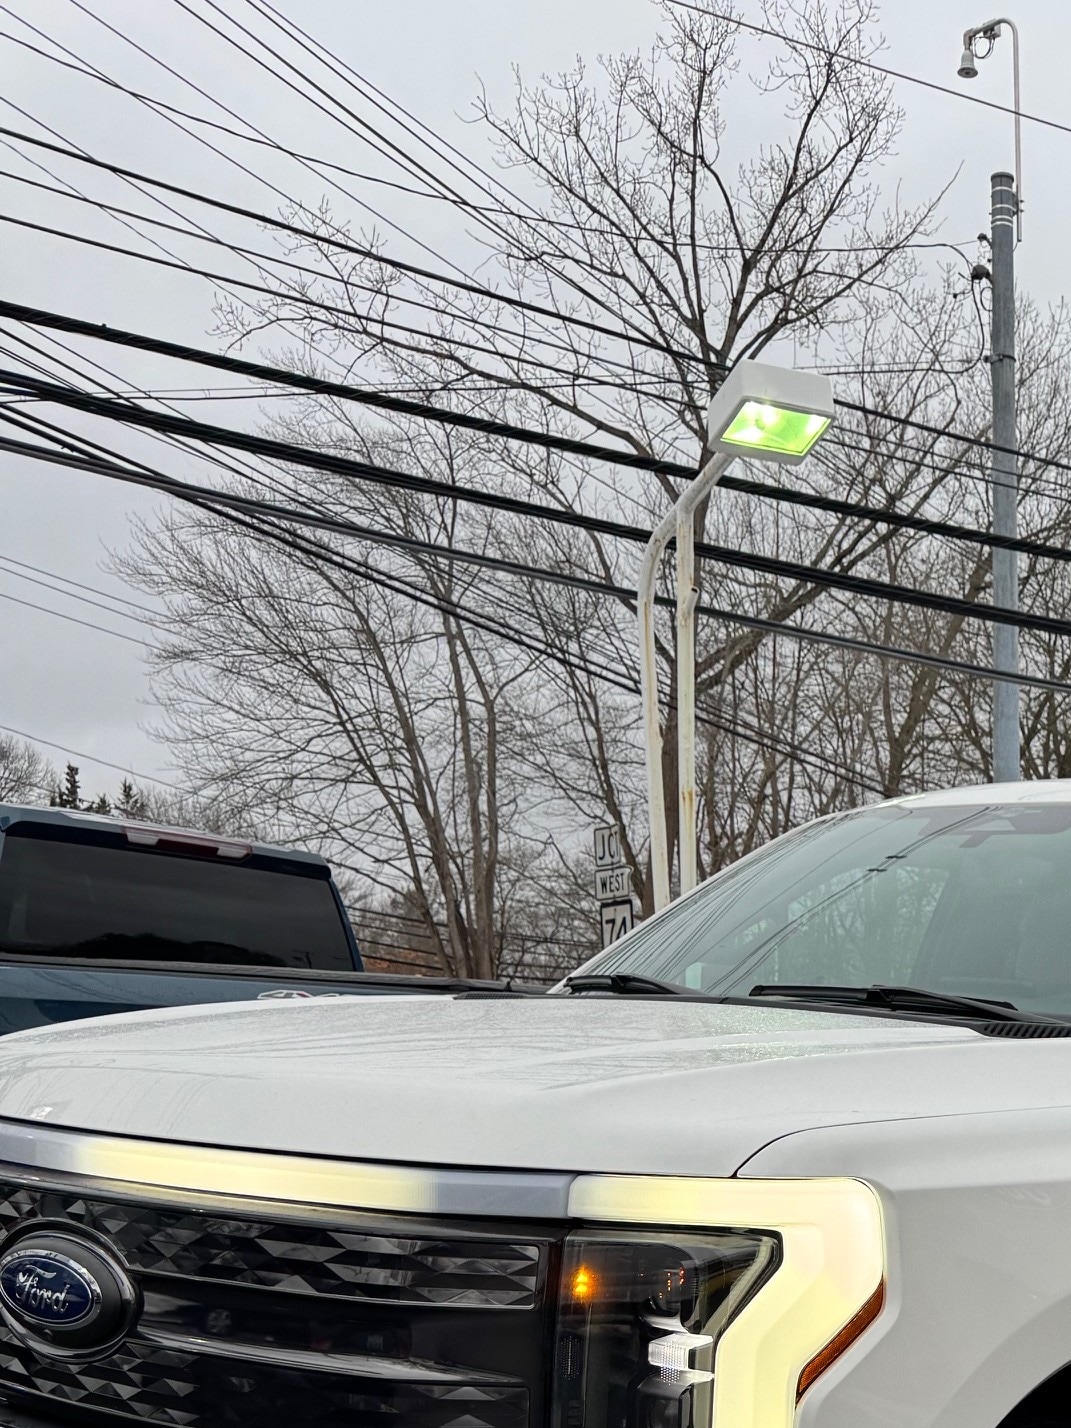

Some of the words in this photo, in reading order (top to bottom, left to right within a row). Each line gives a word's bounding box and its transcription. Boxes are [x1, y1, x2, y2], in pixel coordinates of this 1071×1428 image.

[598, 831, 619, 861] JCT
[600, 873, 625, 895] WEST
[15, 1264, 71, 1314] Ford
